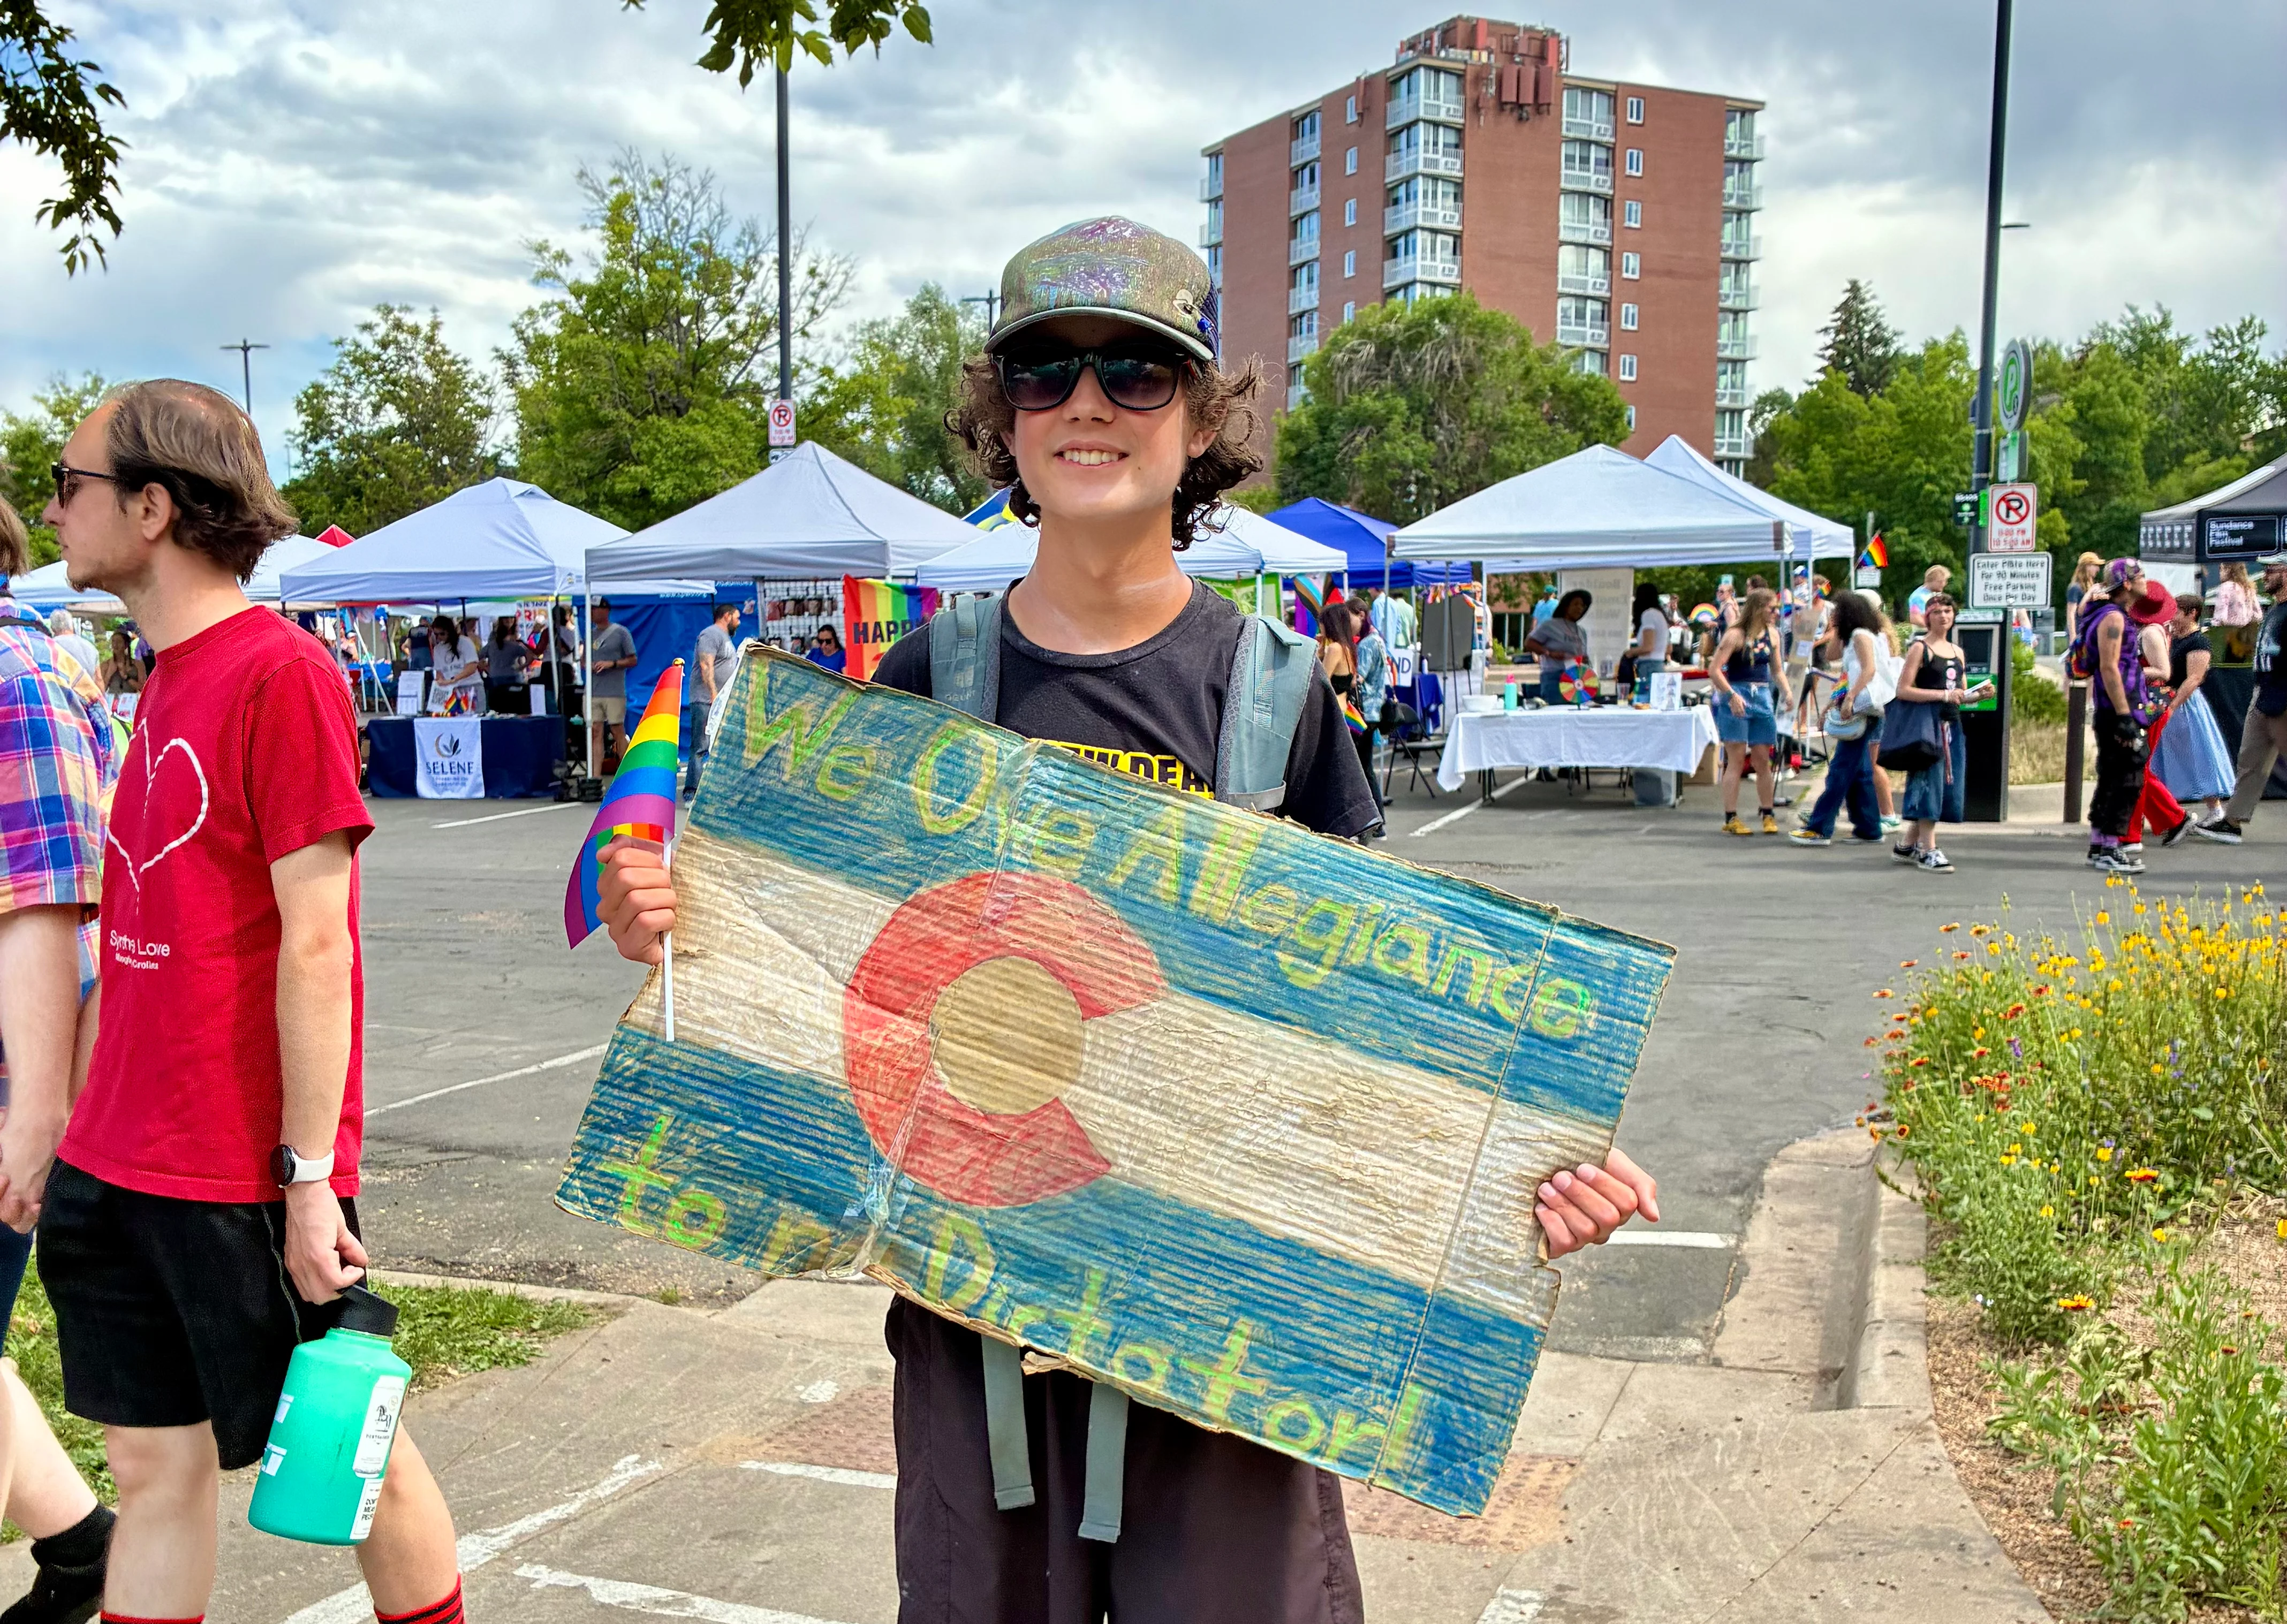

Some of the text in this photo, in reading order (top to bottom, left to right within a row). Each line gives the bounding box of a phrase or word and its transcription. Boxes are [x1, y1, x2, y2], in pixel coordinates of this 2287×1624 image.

[2209, 520, 2254, 530] Sundance
[2209, 536, 2243, 547] Festival
[1977, 559, 2045, 569] Enter Plate Here
[1981, 571, 2040, 579] For 90 Minutes
[1984, 582, 2036, 591] Free Parking
[1983, 593, 2002, 602] Once
[2021, 593, 2036, 602] Day
[853, 619, 922, 644] HAPP
[426, 761, 474, 775] SELENE
[741, 656, 878, 803] We
[1107, 802, 1593, 1040] Allegiance
[137, 938, 170, 957] Love
[595, 1113, 727, 1250] to
